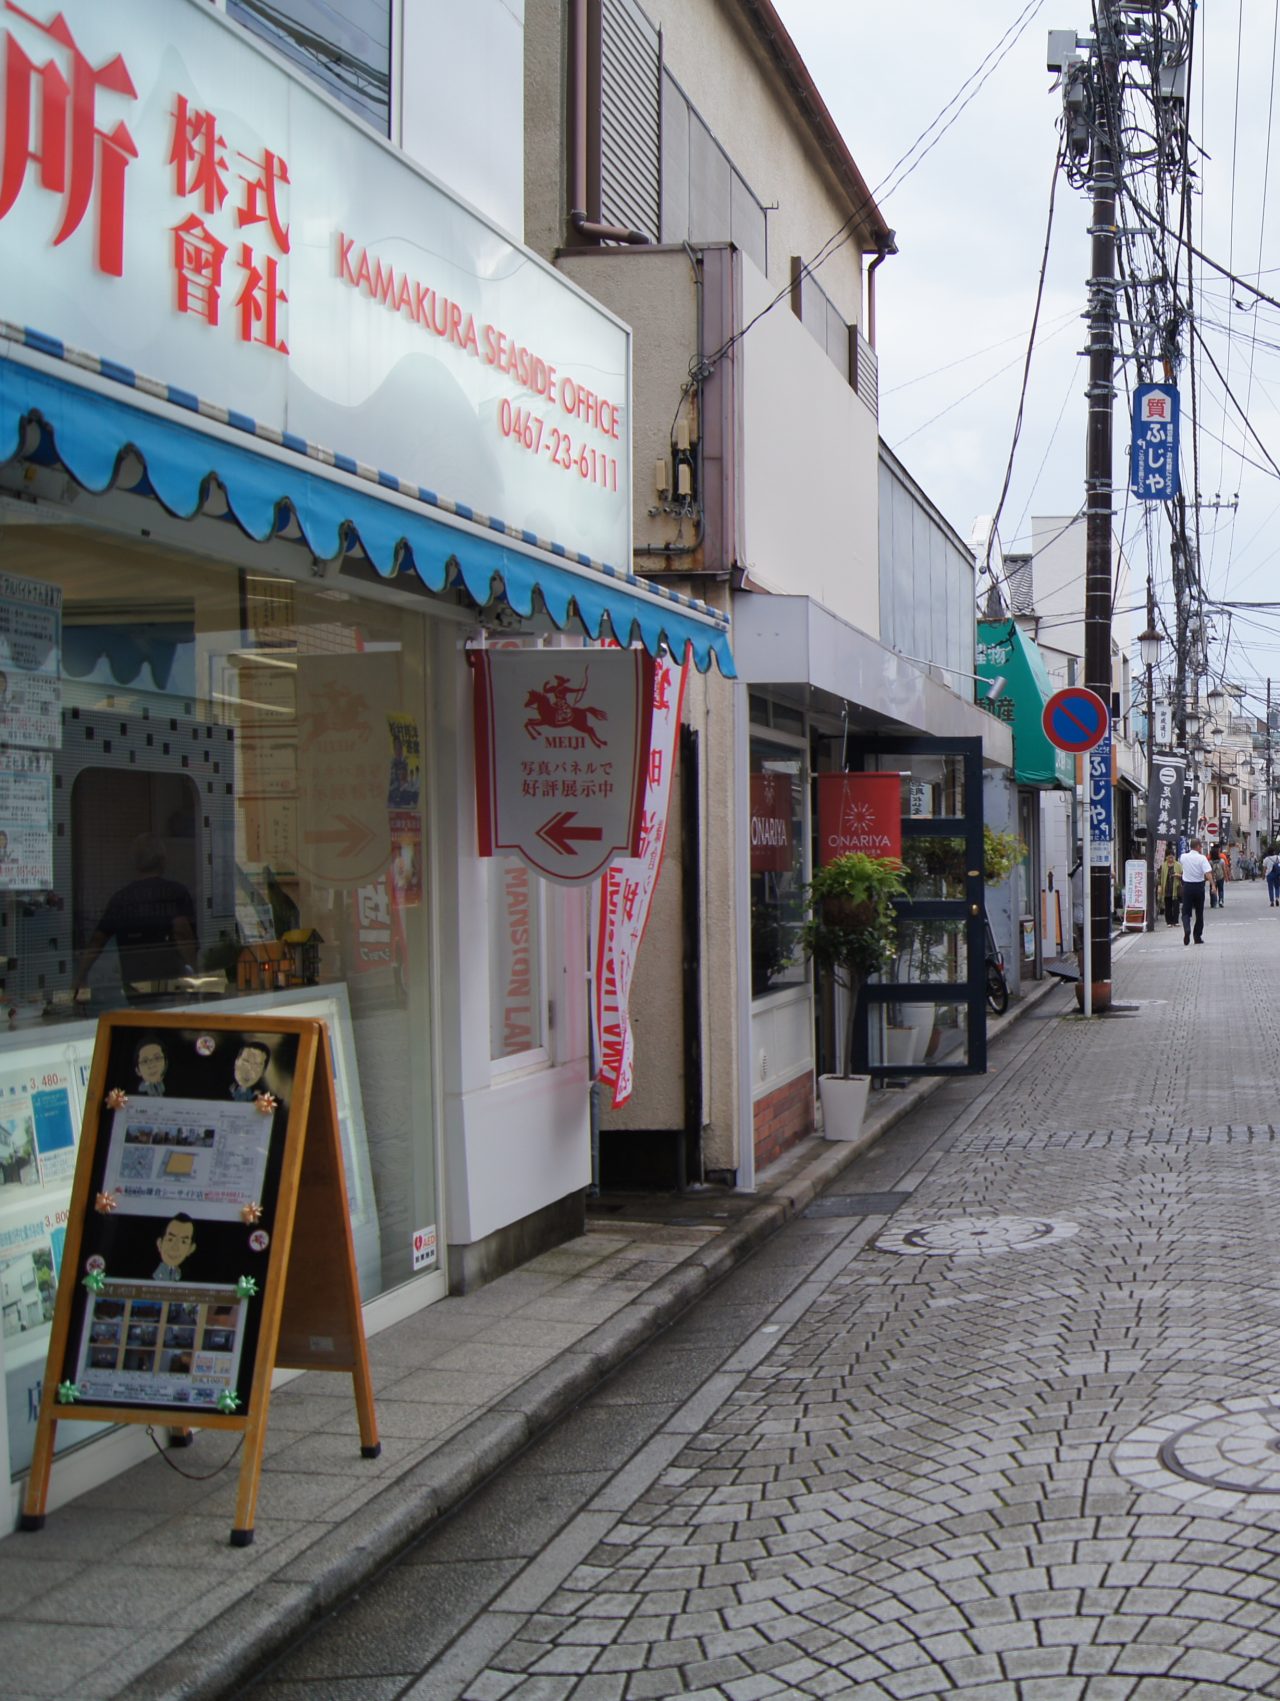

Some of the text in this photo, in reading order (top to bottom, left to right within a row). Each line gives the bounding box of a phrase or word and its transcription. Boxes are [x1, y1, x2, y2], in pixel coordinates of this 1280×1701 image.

[165, 92, 290, 254] 株式
[337, 232, 619, 440] KAMAKURA SEASIDE OFFICE
[1147, 398, 1166, 418] 質
[500, 398, 618, 492] 0467-23-6111
[1146, 423, 1166, 493] ふじや
[545, 736, 585, 749] MEIJI
[521, 761, 614, 776] 写真パネルで
[522, 779, 614, 798] 好評展示中
[1090, 757, 1106, 825] ふじや
[751, 816, 788, 846] ONARIYA
[828, 835, 891, 847] ONARIYA
[503, 867, 532, 998] MANSION
